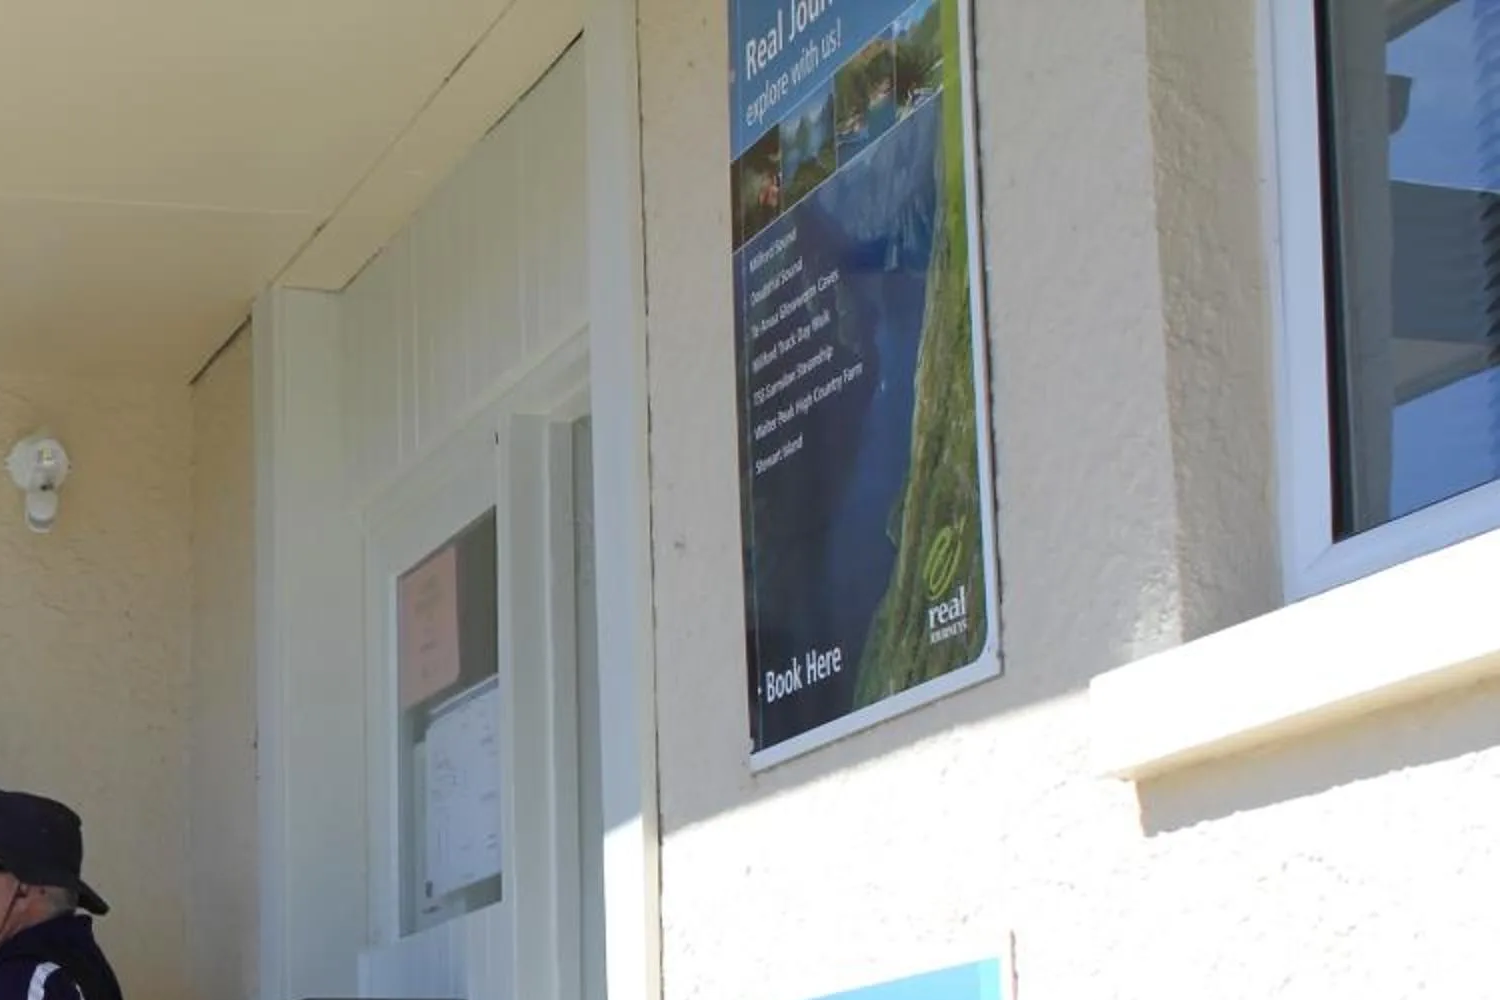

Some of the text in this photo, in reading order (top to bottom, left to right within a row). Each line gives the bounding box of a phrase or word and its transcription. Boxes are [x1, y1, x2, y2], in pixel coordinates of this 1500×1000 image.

[746, 8, 783, 80] Real
[746, 17, 842, 127] explore with us!
[928, 584, 966, 629] real
[765, 646, 842, 704] Book Here
